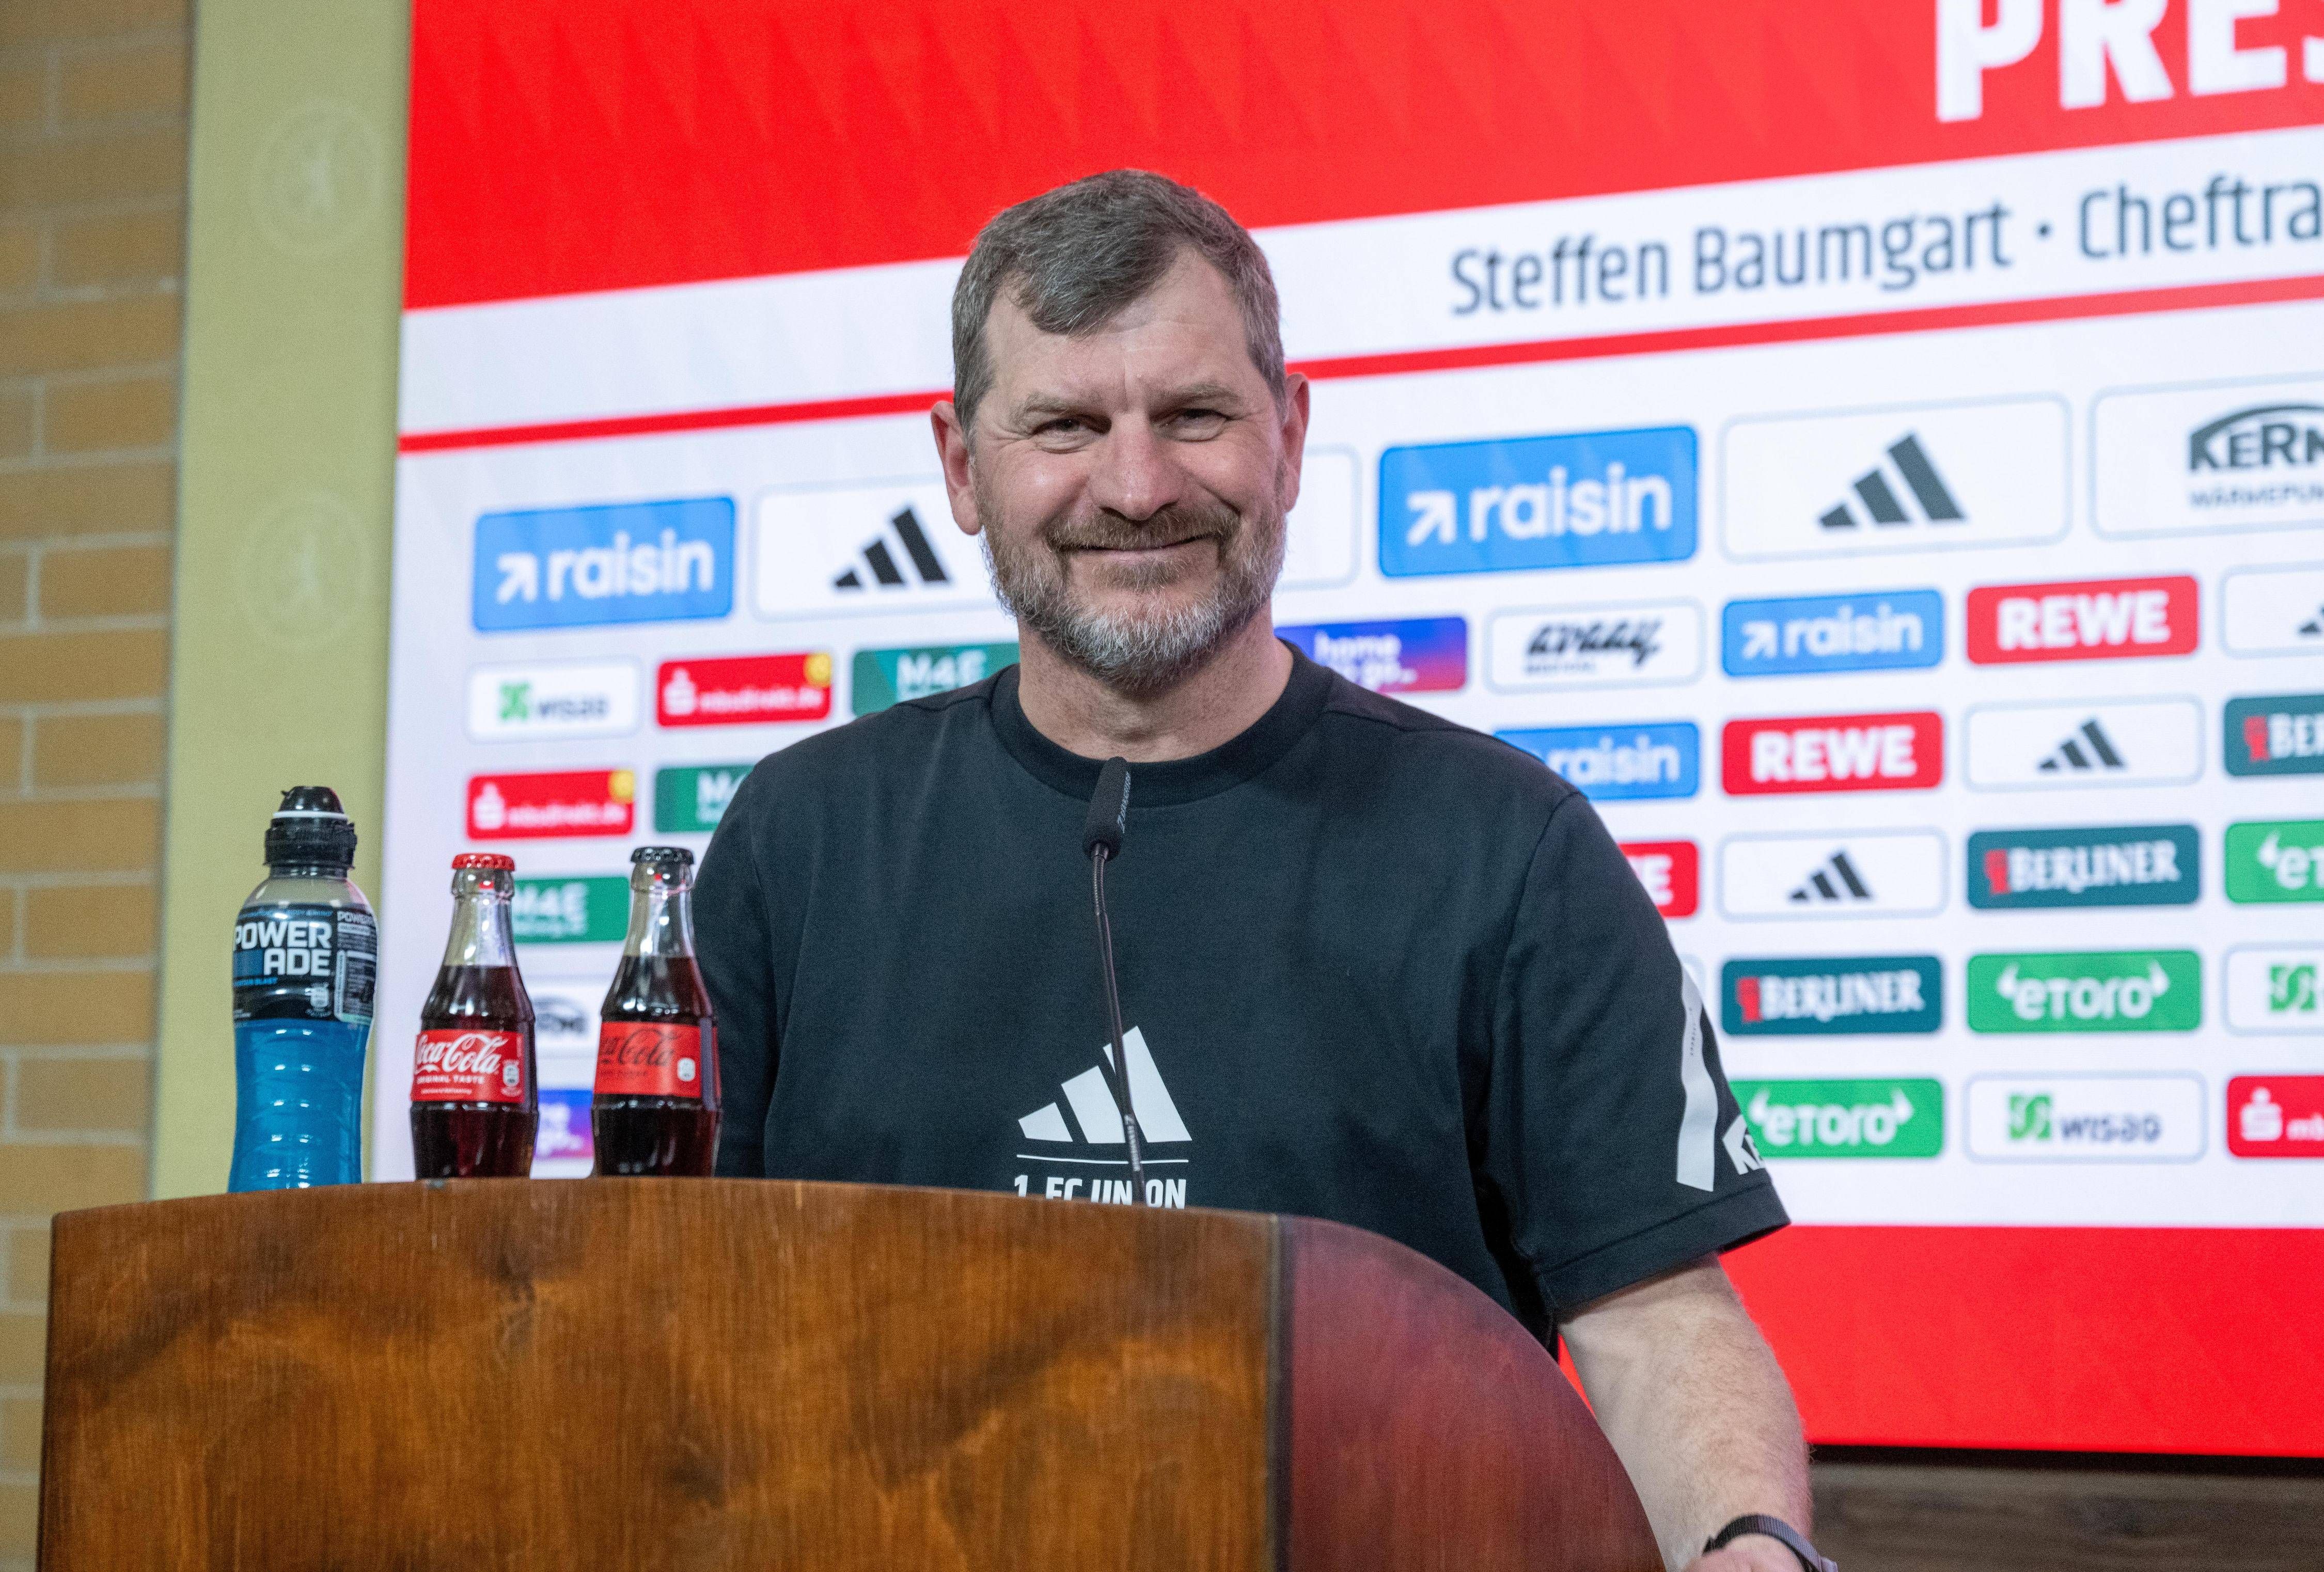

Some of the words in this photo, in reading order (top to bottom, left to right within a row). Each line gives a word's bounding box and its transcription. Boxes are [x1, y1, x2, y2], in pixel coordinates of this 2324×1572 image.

[1451, 232, 1669, 317] Steffen
[1694, 203, 2012, 292] Baumgart
[1470, 462, 1672, 543] raisin
[546, 527, 715, 602] raisin
[1784, 602, 1924, 658] raisin
[1997, 589, 2171, 651] REWE
[1750, 725, 1918, 783] REWE
[2008, 840, 2182, 894] BERLINER
[263, 948, 331, 976] ADE
[1761, 969, 1926, 1023] BERLINER
[1091, 1178, 1187, 1210] UNON
